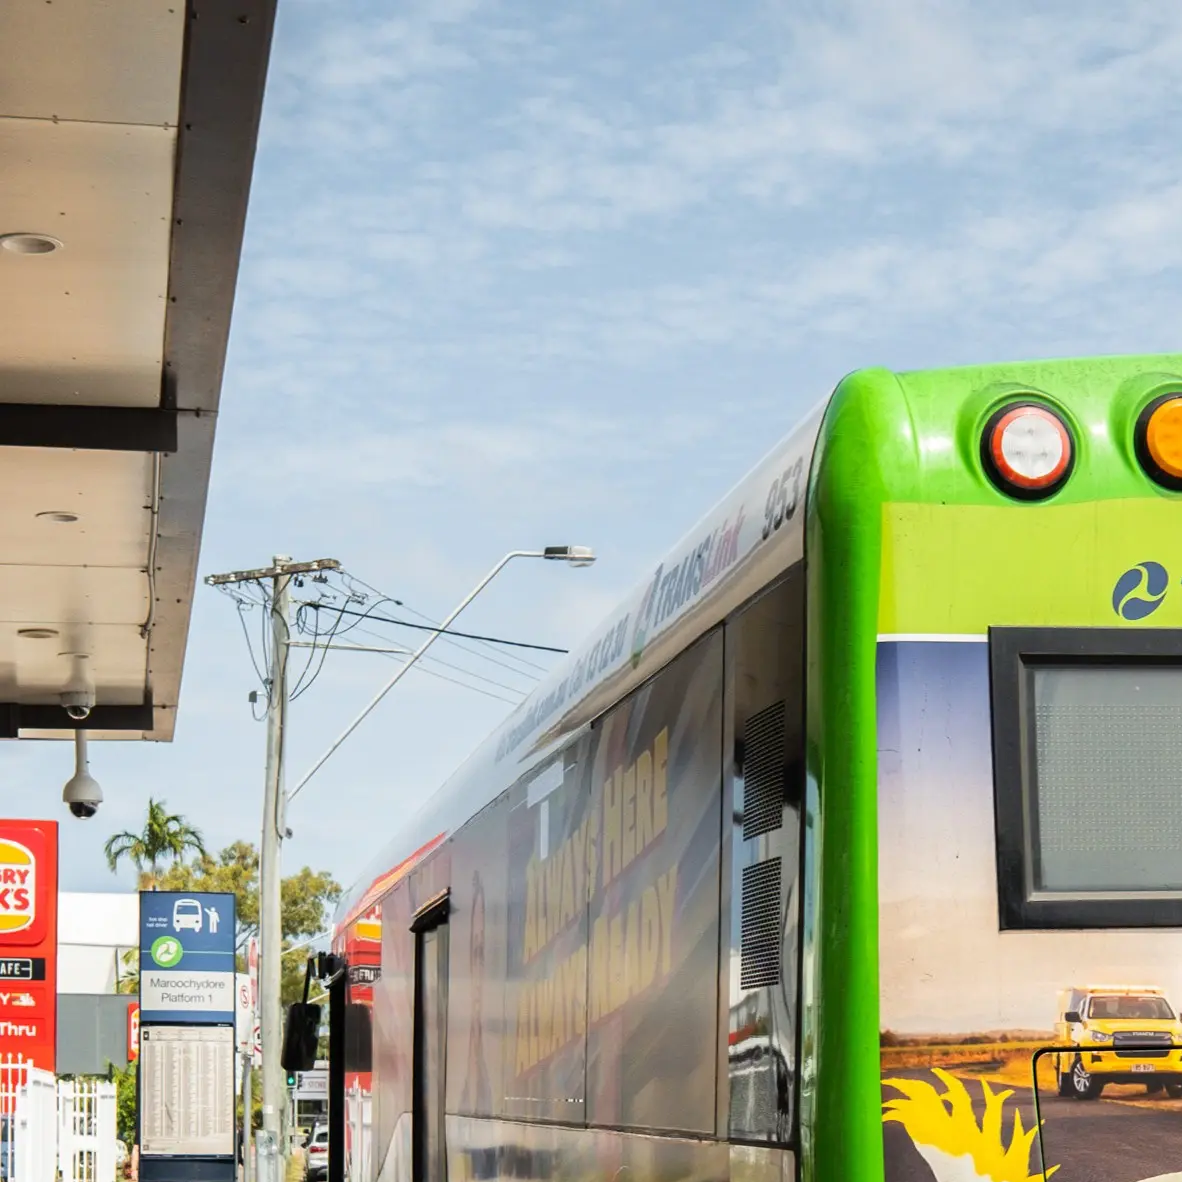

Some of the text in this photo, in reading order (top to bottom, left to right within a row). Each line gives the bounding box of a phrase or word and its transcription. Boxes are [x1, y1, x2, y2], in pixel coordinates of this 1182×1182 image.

[762, 456, 803, 541] 953
[523, 726, 668, 965] ALWAYS HERE
[590, 864, 678, 1025] READY
[149, 978, 225, 990] Maroochydore
[161, 993, 213, 1003] Platform 1
[0, 1021, 37, 1037] Thru
